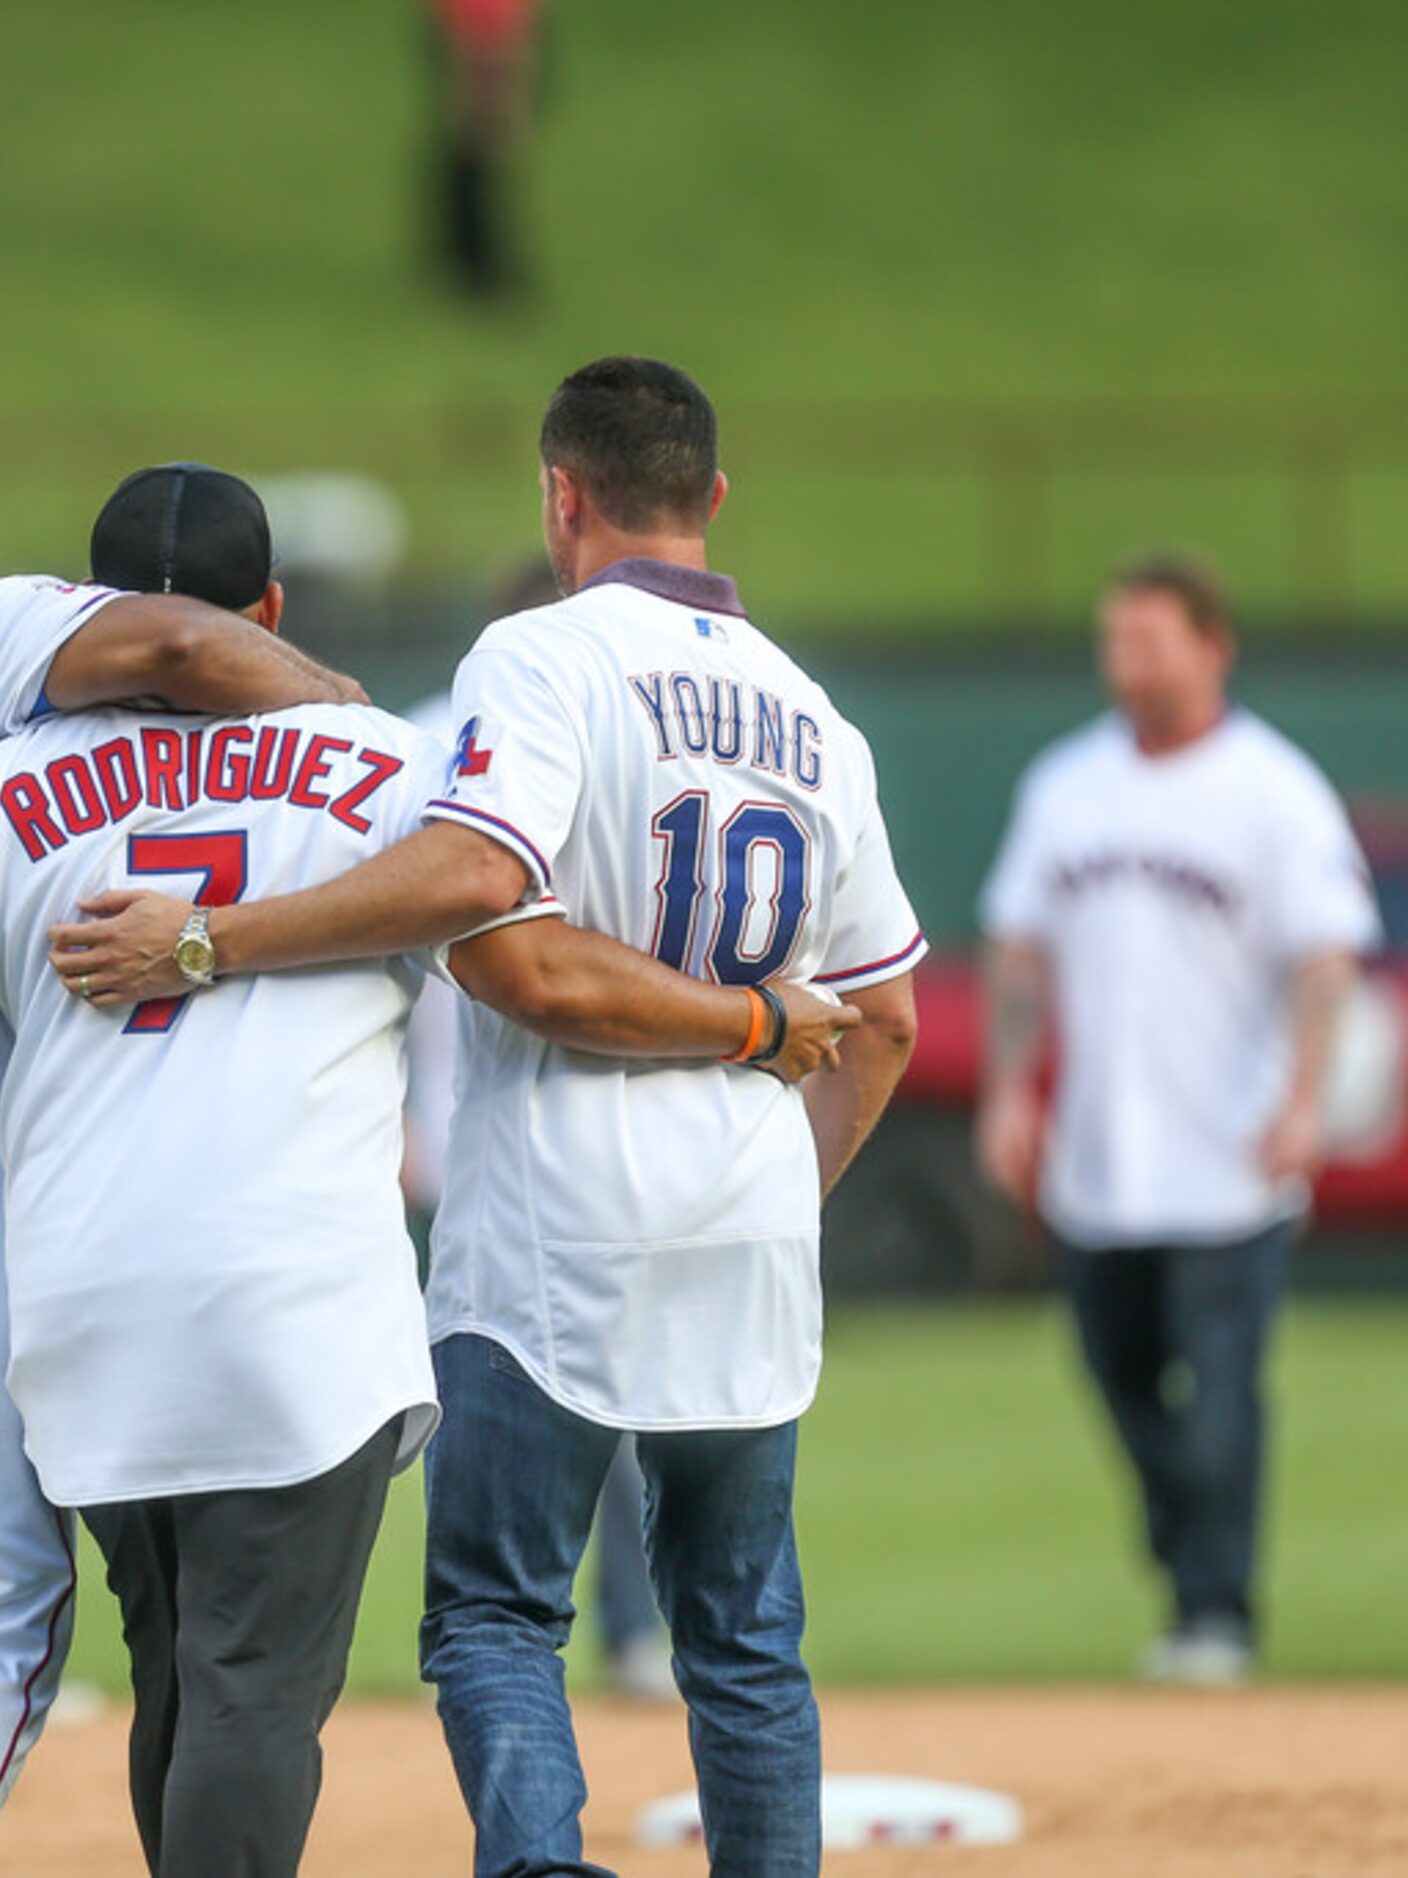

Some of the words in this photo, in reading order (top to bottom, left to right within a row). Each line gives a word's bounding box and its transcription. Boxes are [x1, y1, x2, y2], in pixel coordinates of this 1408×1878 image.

[0, 726, 404, 863] RODRIGUEZ
[627, 671, 823, 792] YOUNG
[122, 829, 248, 1034] 7
[651, 789, 812, 985] 10
